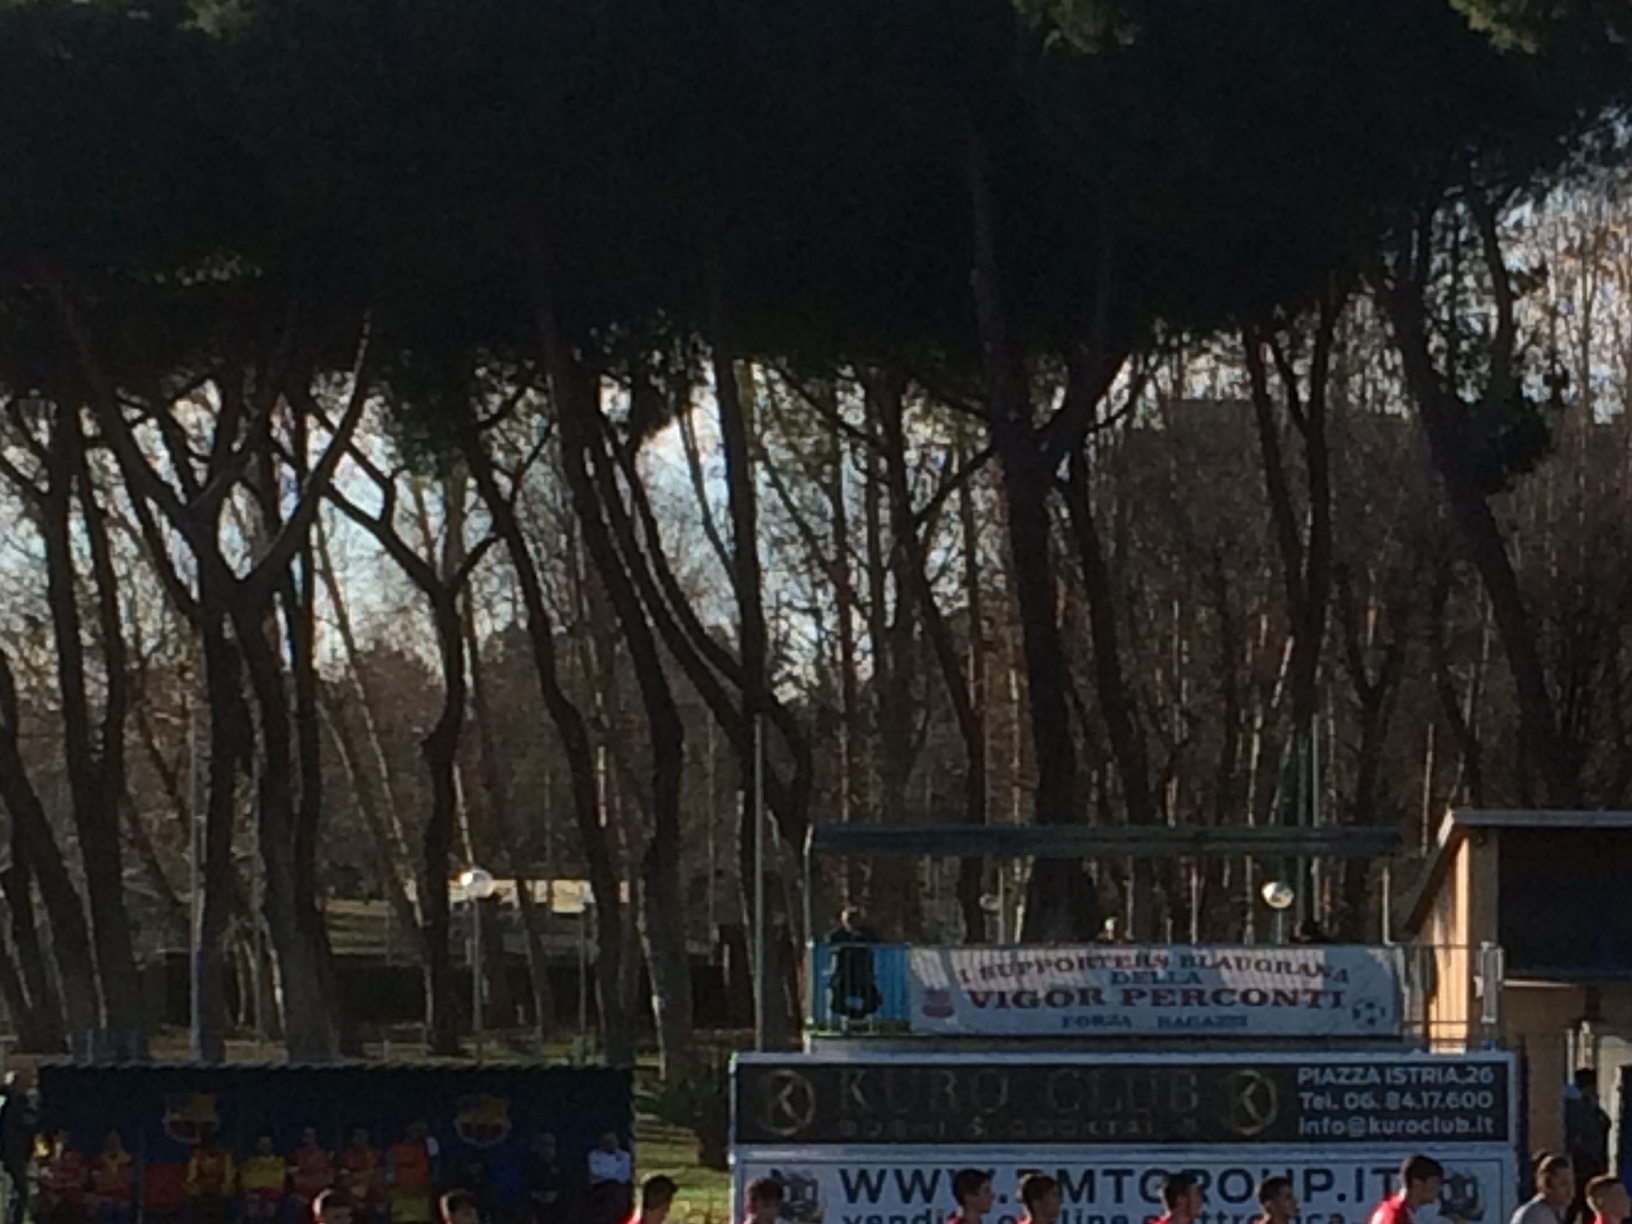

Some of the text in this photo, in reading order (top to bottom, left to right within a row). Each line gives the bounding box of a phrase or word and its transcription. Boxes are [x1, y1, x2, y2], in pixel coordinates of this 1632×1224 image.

[980, 954, 1169, 982] SUPPORTERS
[1180, 955, 1349, 984] BLAUGRANA
[1110, 970, 1203, 985] DELLA
[967, 987, 1347, 1010] VIGOR PERCONTI
[1061, 1014, 1132, 1029] FORZA
[1299, 1066, 1381, 1085] PIAZZA
[839, 1068, 1199, 1114] KURO CLUB
[1299, 1091, 1339, 1110] Tel.
[839, 1167, 1401, 1205] WW.MTGOP.IT
